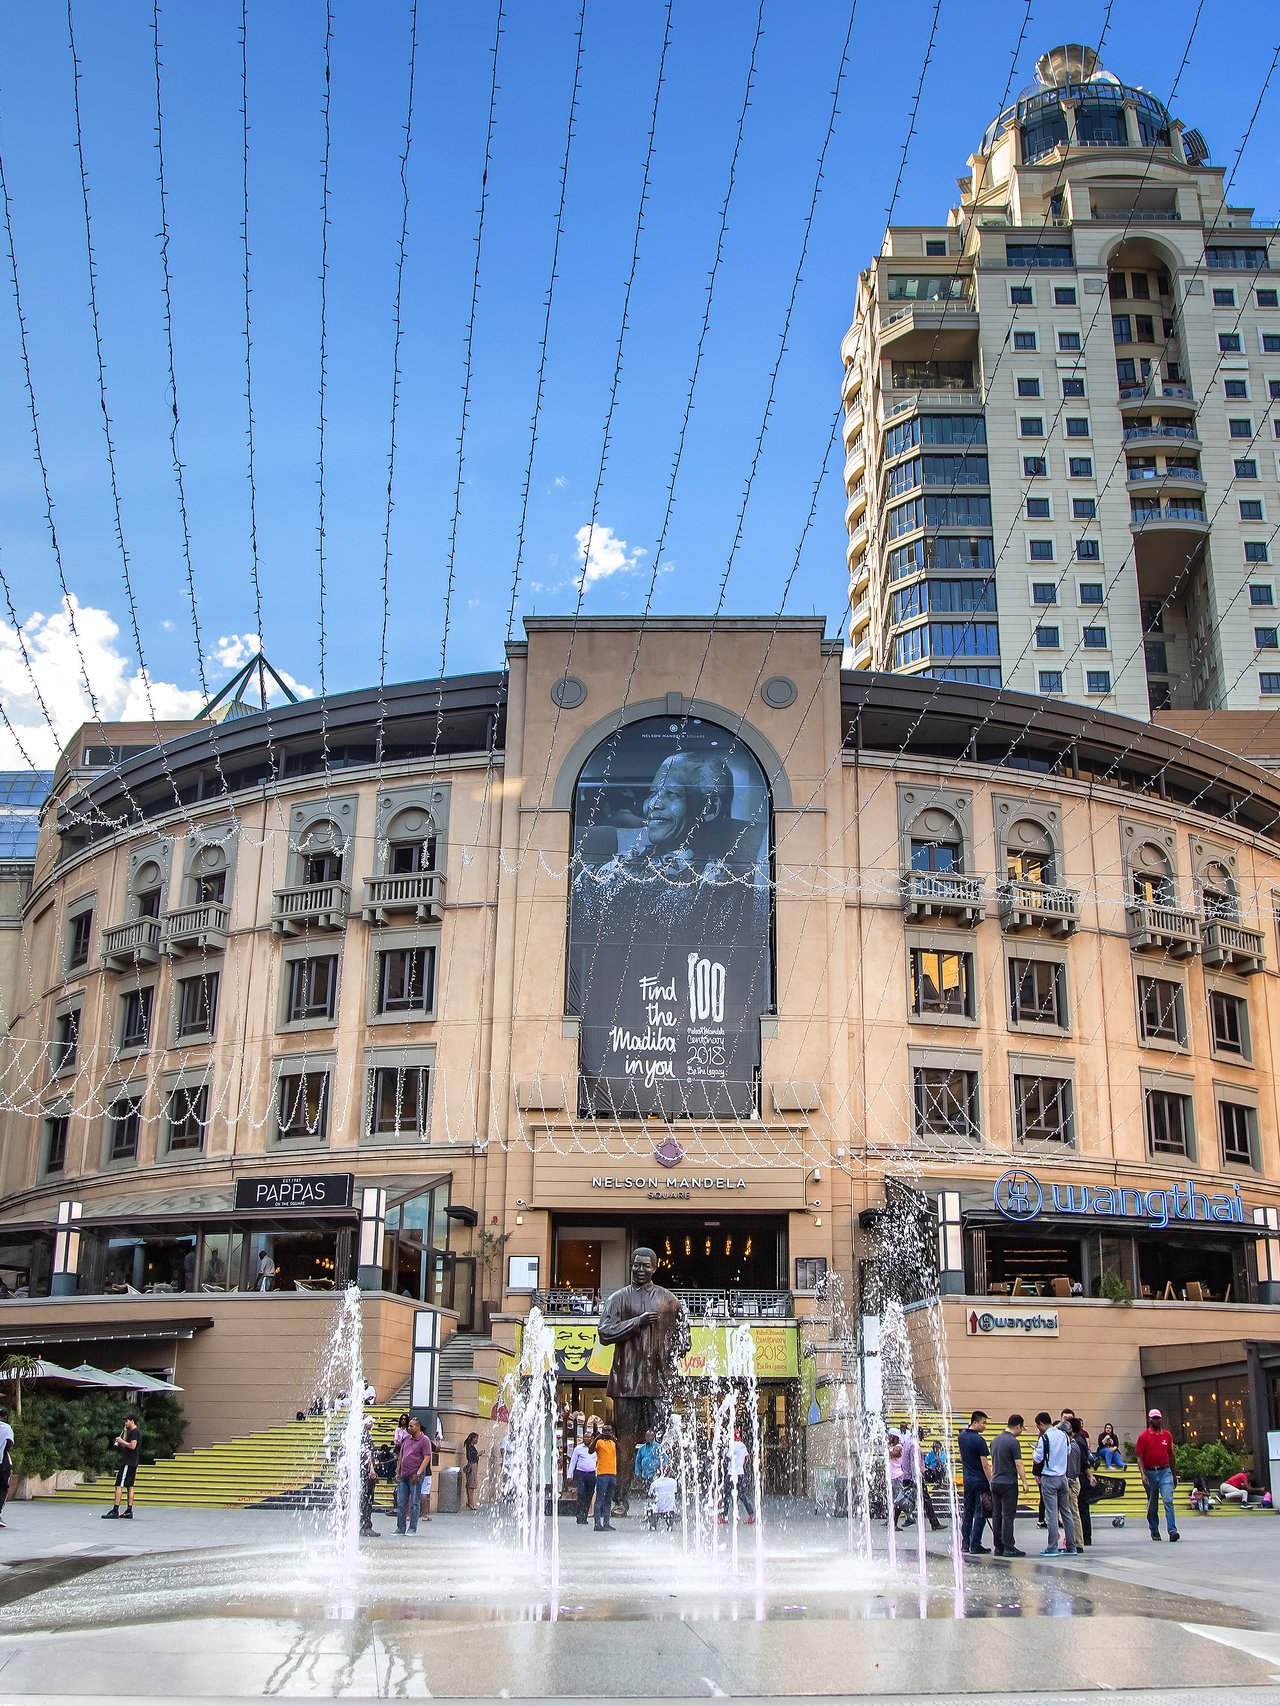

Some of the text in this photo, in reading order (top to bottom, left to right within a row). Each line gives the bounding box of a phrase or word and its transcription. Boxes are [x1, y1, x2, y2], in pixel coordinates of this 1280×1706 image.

[639, 976, 677, 1001] Find
[687, 952, 726, 1023] 100
[645, 1002, 677, 1026] the
[609, 1026, 677, 1052] Madiba
[686, 1046, 725, 1065] 2018
[625, 1054, 676, 1088] in you
[256, 1182, 326, 1202] PAPPAS
[592, 1177, 746, 1188] NELSON MANDELA
[1051, 1180, 1245, 1229] wangthai
[994, 1315, 1058, 1331] wangthai
[756, 1345, 787, 1361] 2018
